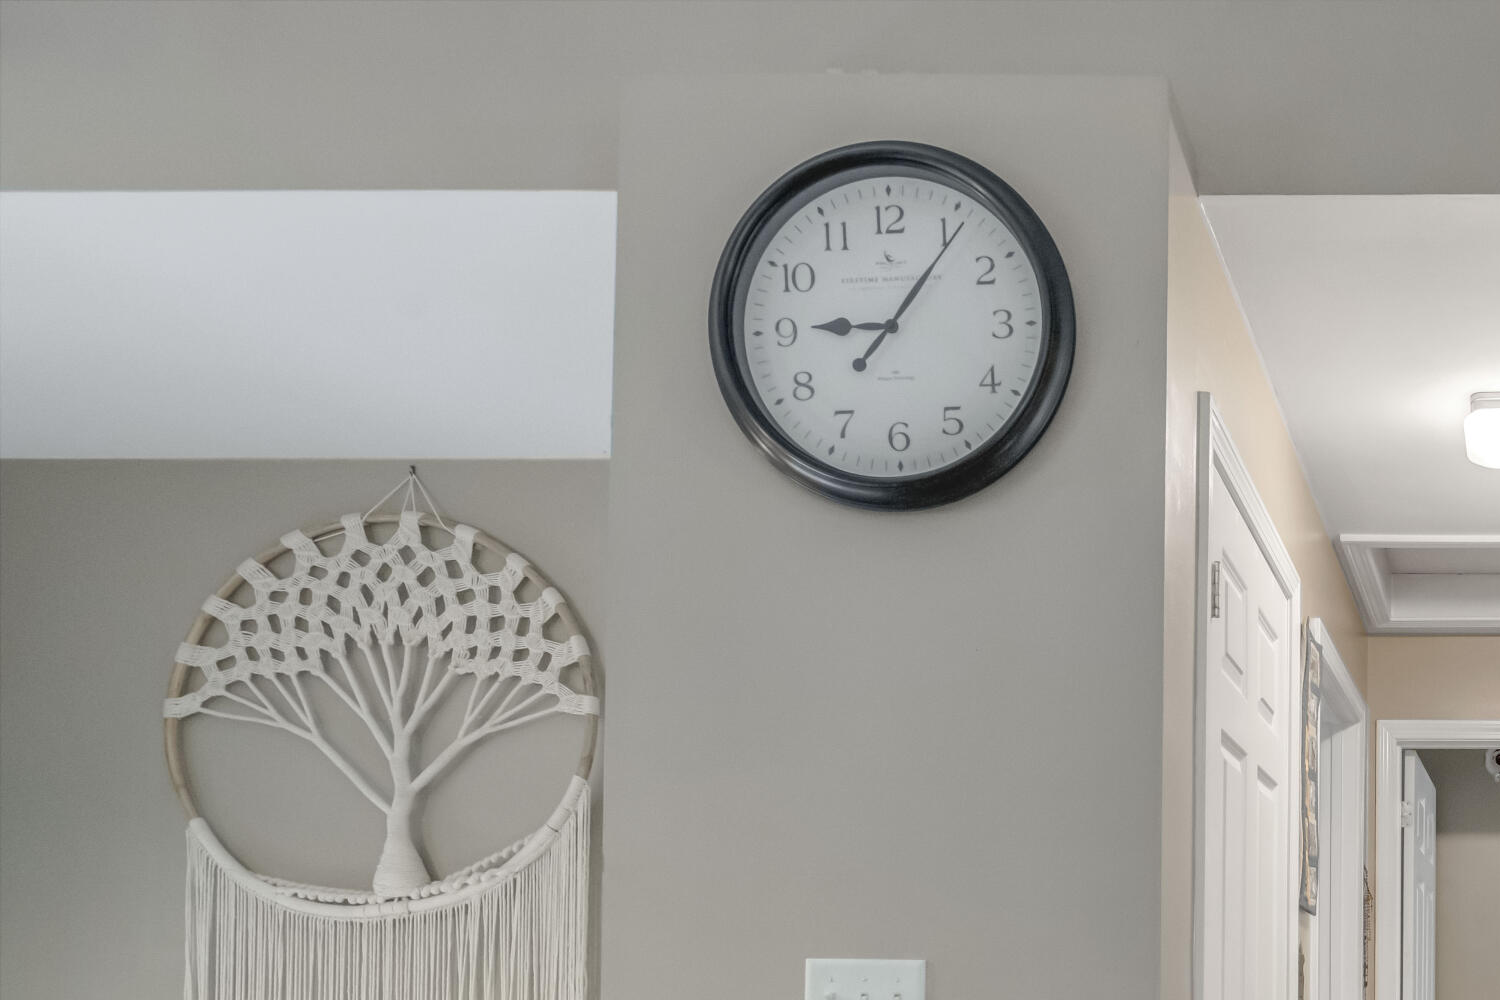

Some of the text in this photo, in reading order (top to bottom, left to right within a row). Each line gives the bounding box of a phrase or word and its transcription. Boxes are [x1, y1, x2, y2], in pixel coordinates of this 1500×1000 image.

[875, 205, 906, 235] 12
[940, 217, 950, 248] 1
[824, 221, 849, 251] 11
[782, 262, 815, 293] 10
[976, 256, 996, 285] 2
[774, 317, 798, 347] 9
[992, 309, 1014, 339] 3
[792, 371, 815, 401] 8
[979, 365, 1002, 395] 4
[834, 410, 855, 440] 7
[942, 406, 964, 436] 5
[888, 422, 911, 452] 6
